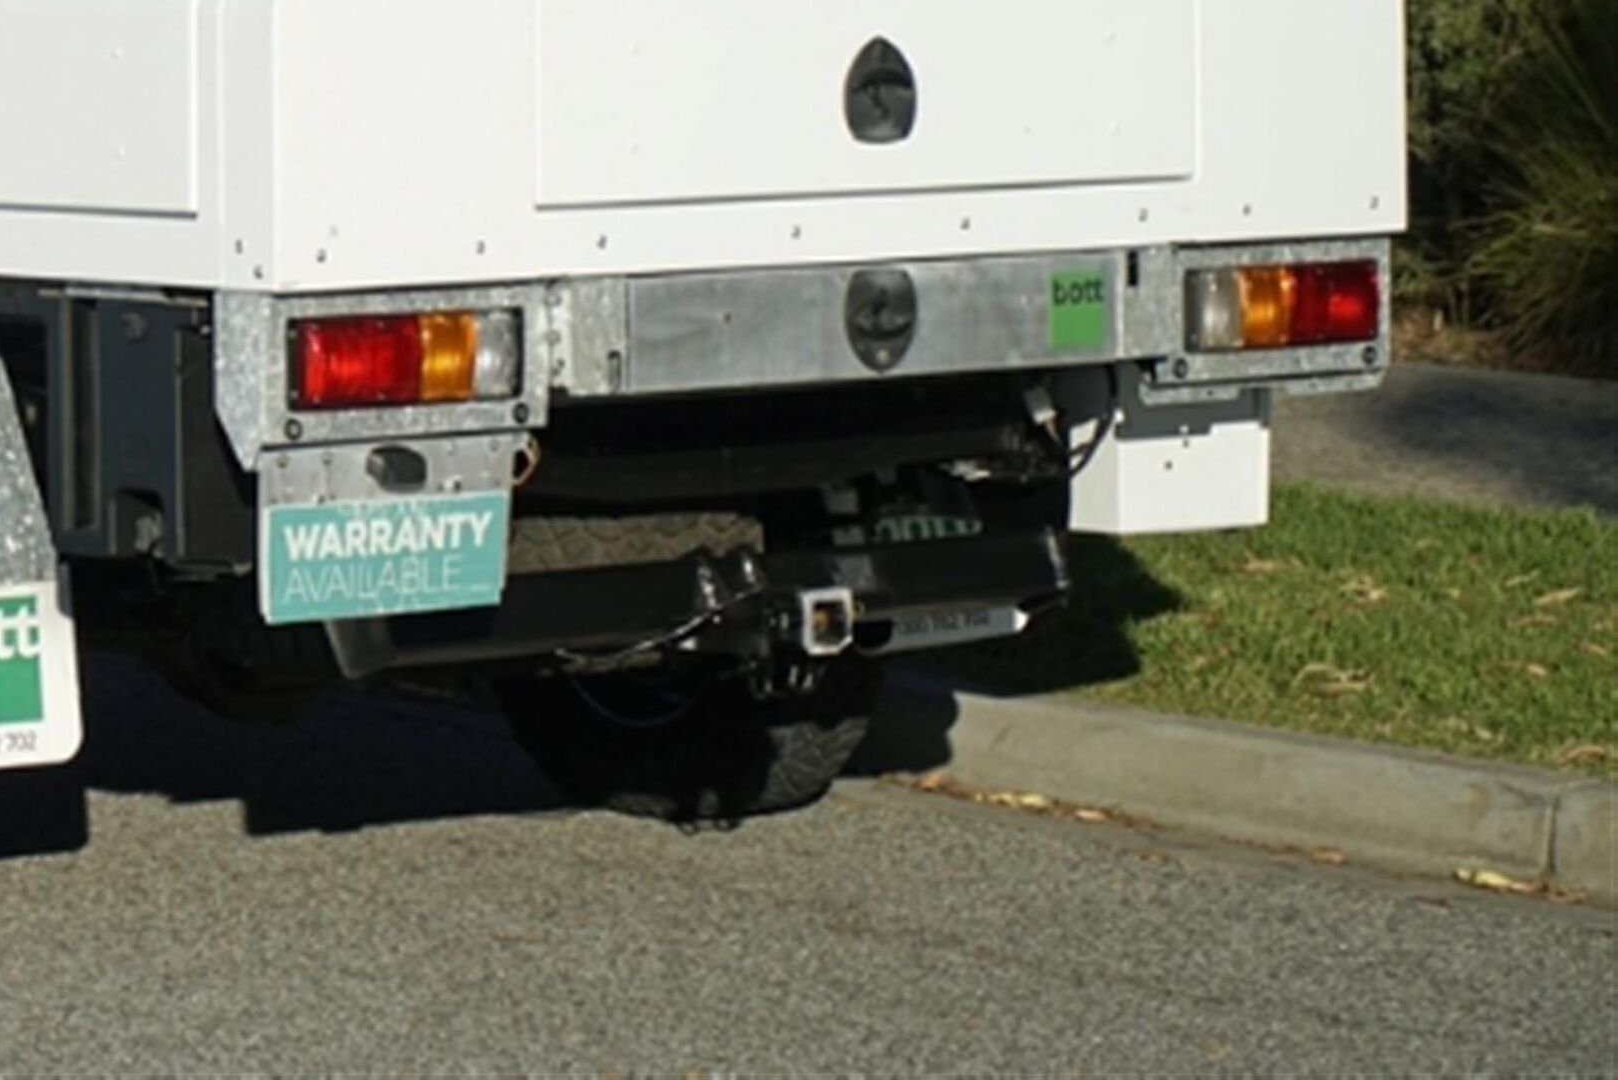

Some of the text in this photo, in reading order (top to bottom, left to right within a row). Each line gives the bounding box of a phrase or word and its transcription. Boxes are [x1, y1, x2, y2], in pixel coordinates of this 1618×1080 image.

[1053, 271, 1103, 307] bott
[284, 511, 493, 562] WARRANTY
[283, 553, 464, 605] AVAILABLE
